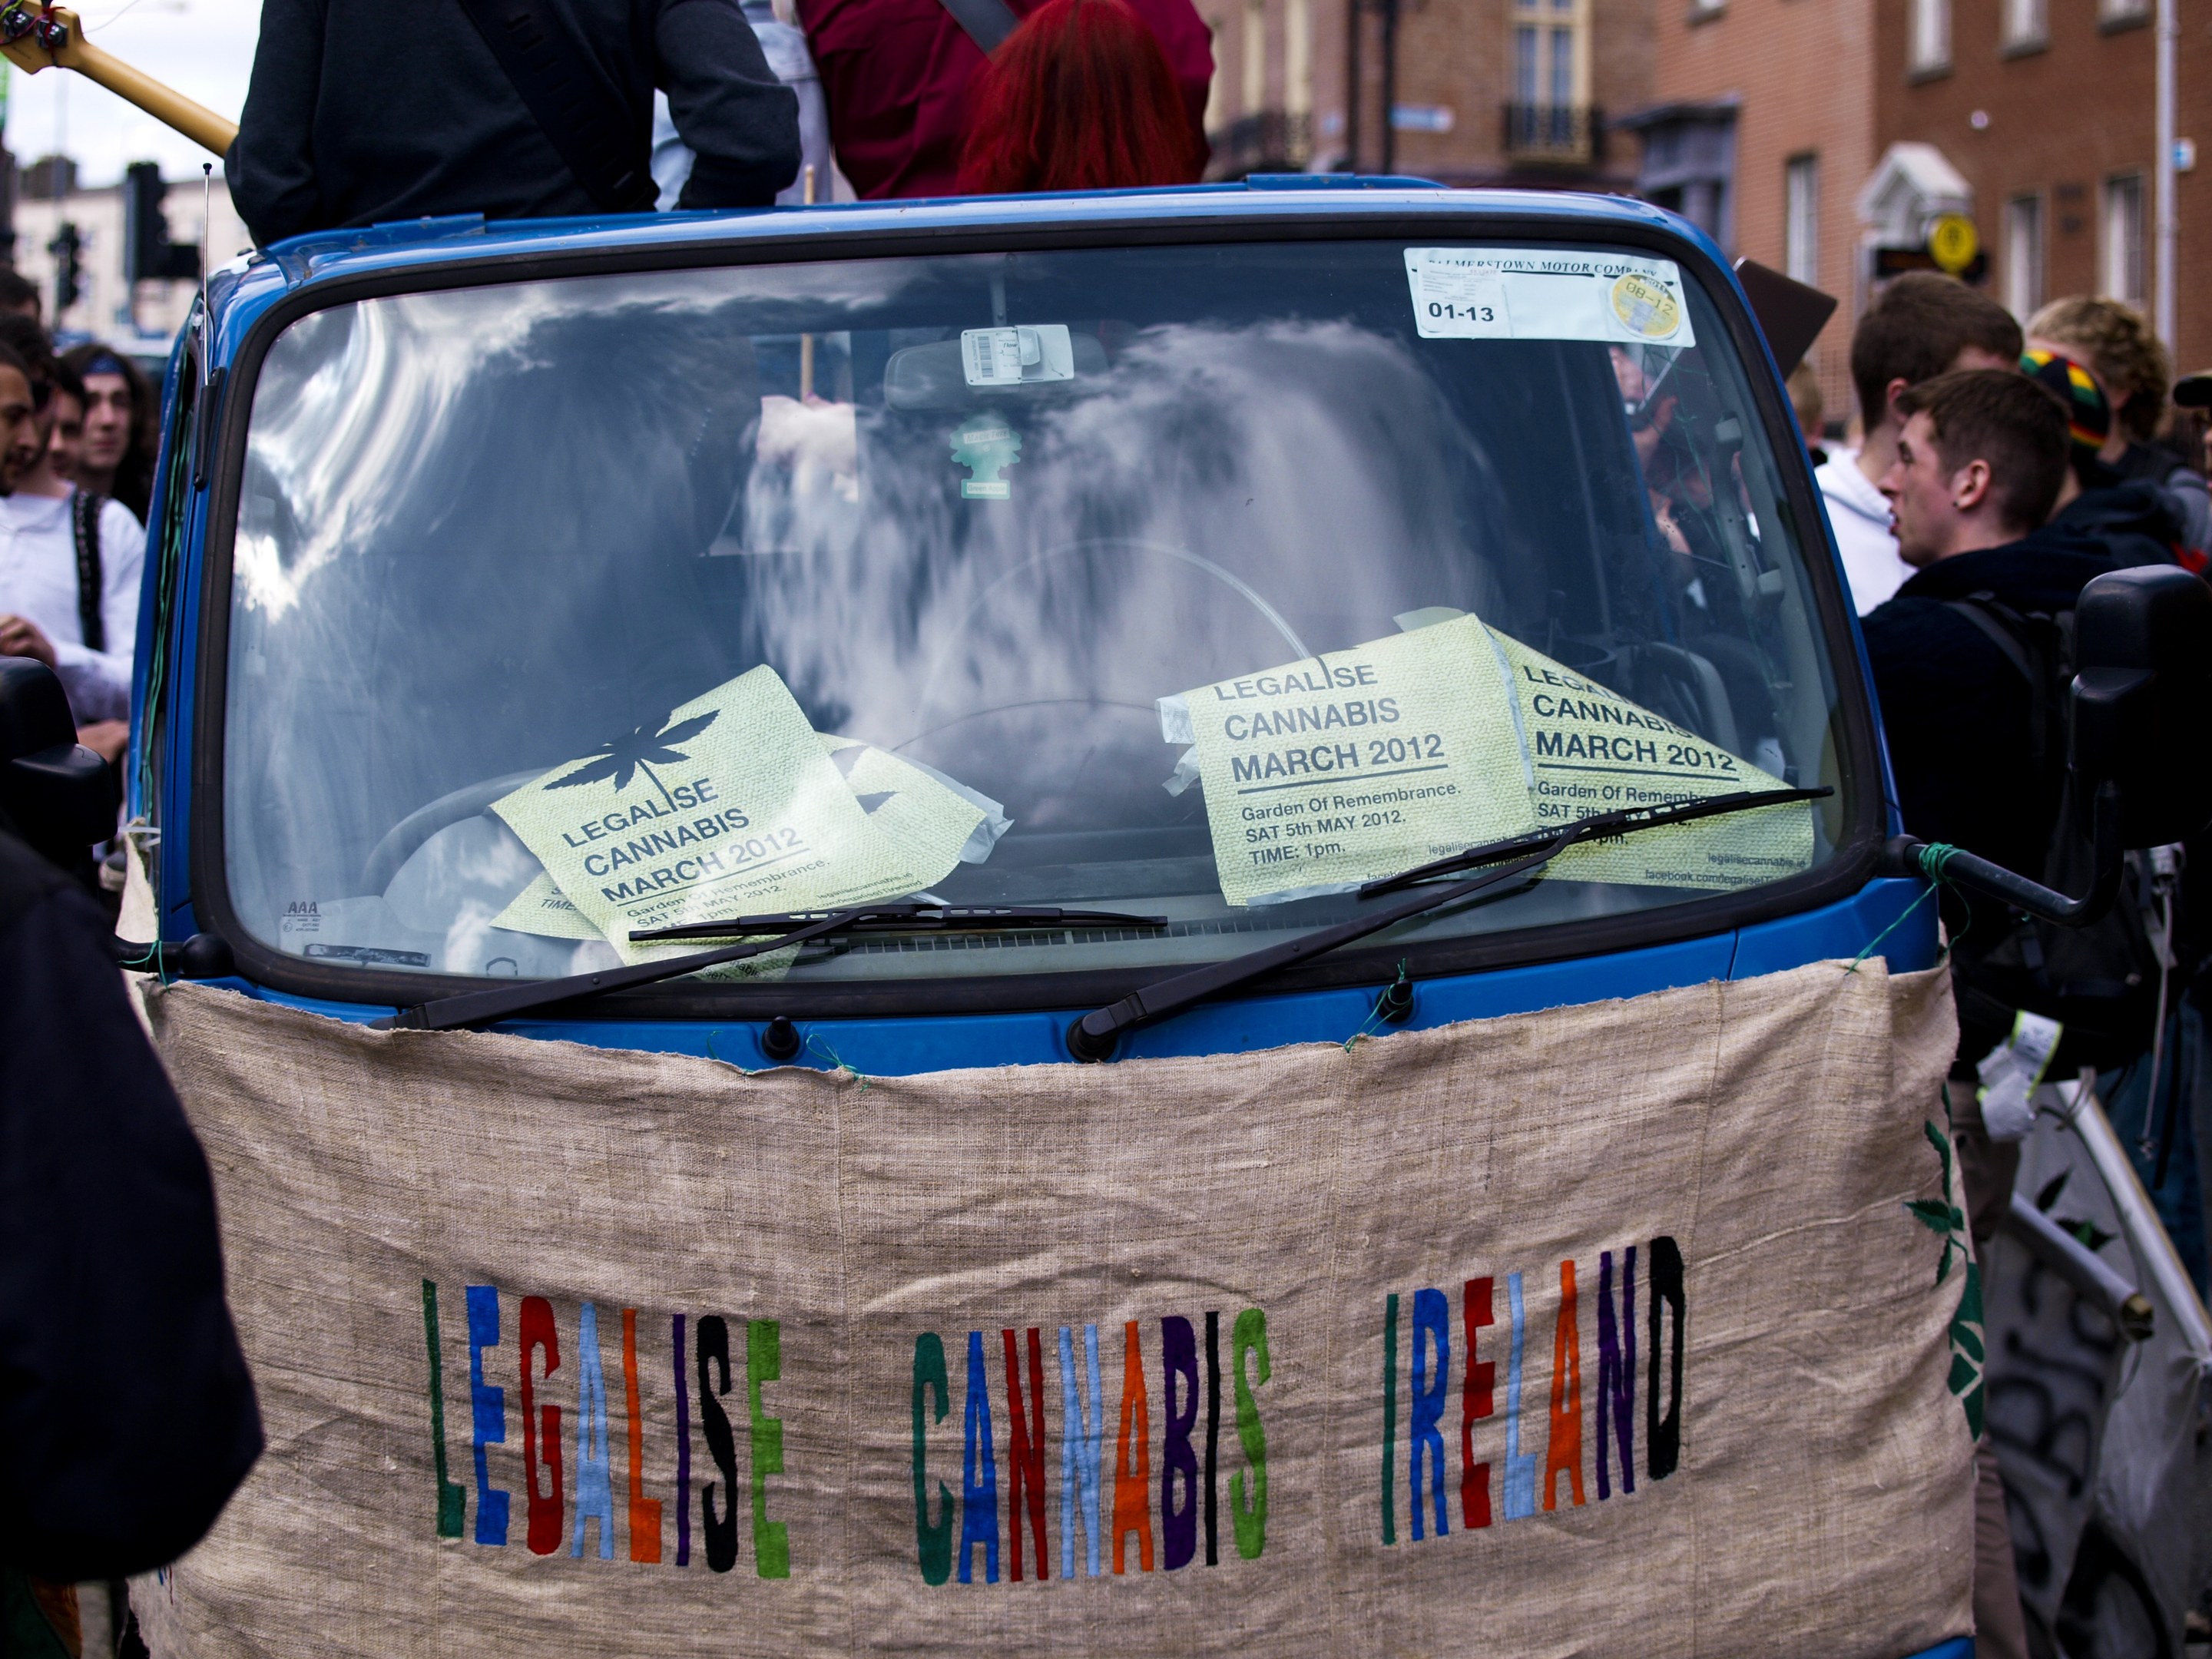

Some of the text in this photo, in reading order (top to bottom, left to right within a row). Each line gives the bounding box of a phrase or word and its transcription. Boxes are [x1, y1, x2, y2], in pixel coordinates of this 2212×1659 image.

[1541, 261, 1590, 273] MOTOR
[1429, 302, 1494, 322] 01-13
[1626, 282, 1673, 316] 08-12
[1214, 664, 1378, 701] LEGALISE
[1224, 697, 1400, 740] CANNABIS
[1231, 733, 1445, 783] MARCH 2012
[1536, 731, 1737, 771] MARCH 2012
[1241, 783, 1462, 821] Garden Of Remembrance.
[1538, 781, 1596, 799] Garden
[1602, 785, 1621, 800] Of
[562, 778, 718, 847] LEGALISE
[1245, 810, 1406, 843] SAT 5th MAY 2012.
[1538, 803, 1570, 819] SAT
[584, 808, 750, 876] CANNABIS
[1248, 841, 1346, 866] TIME: 1pm.
[601, 826, 803, 902] MARCH 2012
[288, 901, 317, 913] AAA
[627, 859, 830, 918] Garden Of Remembrance.
[637, 912, 669, 928] SAT
[673, 904, 700, 916] 5th
[703, 895, 740, 909] MAY
[743, 885, 787, 899] 2012.
[698, 907, 738, 920] 1pm.
[422, 1278, 790, 1579] LEGALISE
[912, 1308, 1270, 1586] CANNABIS
[1382, 1236, 1685, 1546] IRELAND
